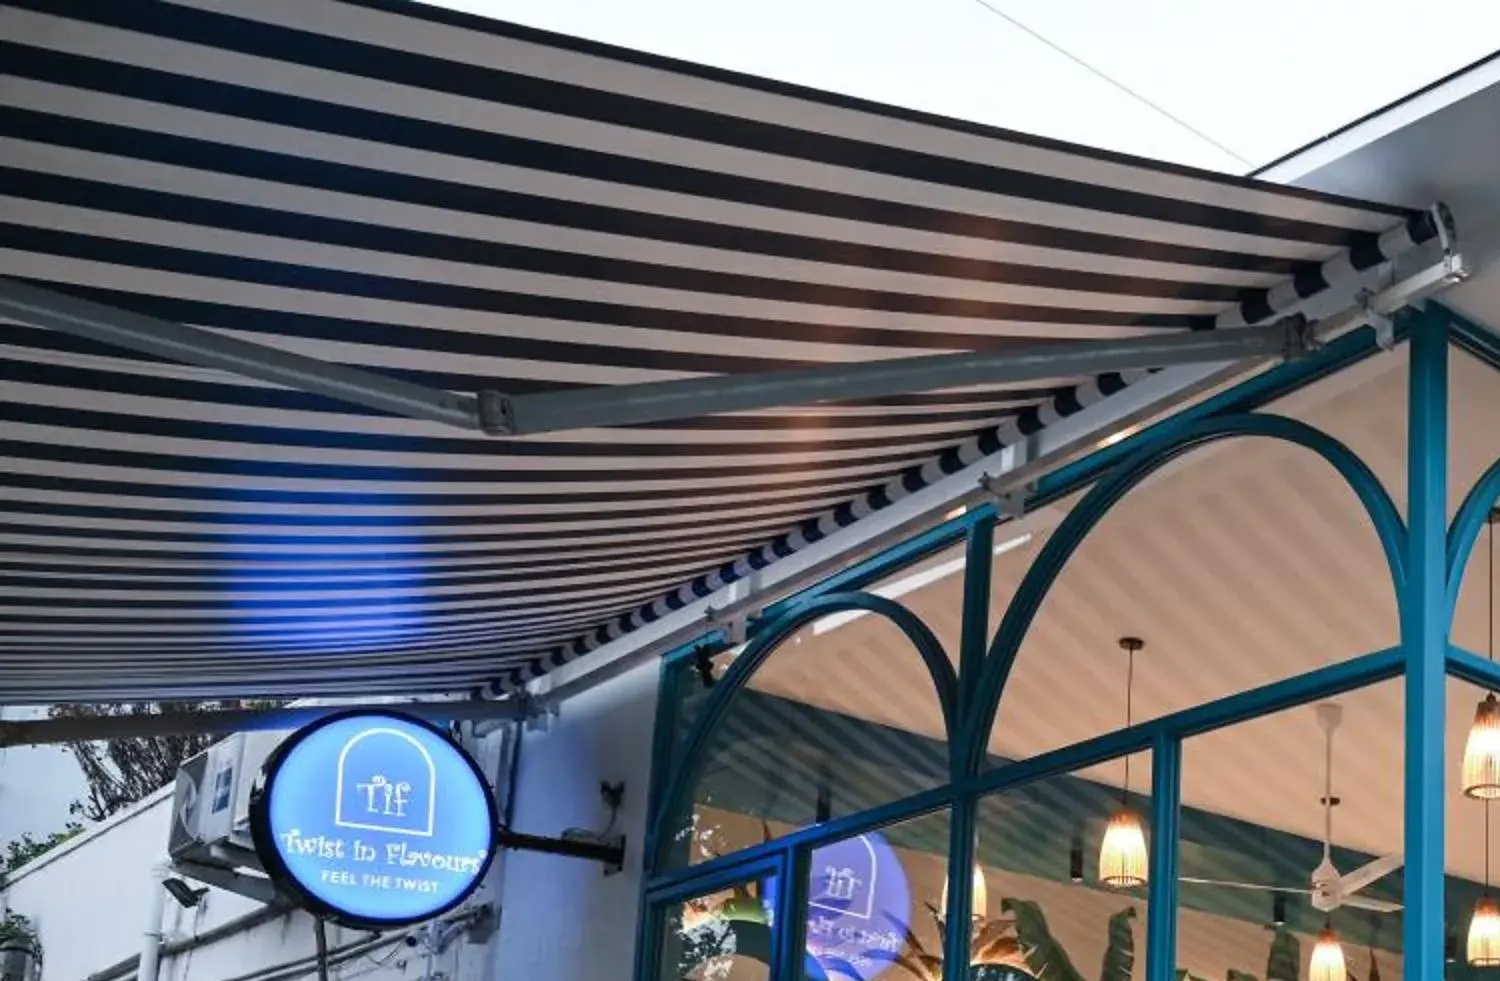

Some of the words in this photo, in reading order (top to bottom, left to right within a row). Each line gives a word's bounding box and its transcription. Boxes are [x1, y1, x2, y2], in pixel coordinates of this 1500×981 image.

[281, 828, 345, 859] Twist
[353, 840, 377, 862] in
[385, 840, 487, 875] Flavours
[321, 869, 357, 885] FEEL
[362, 874, 390, 889] THE
[396, 876, 439, 893] TWIST
